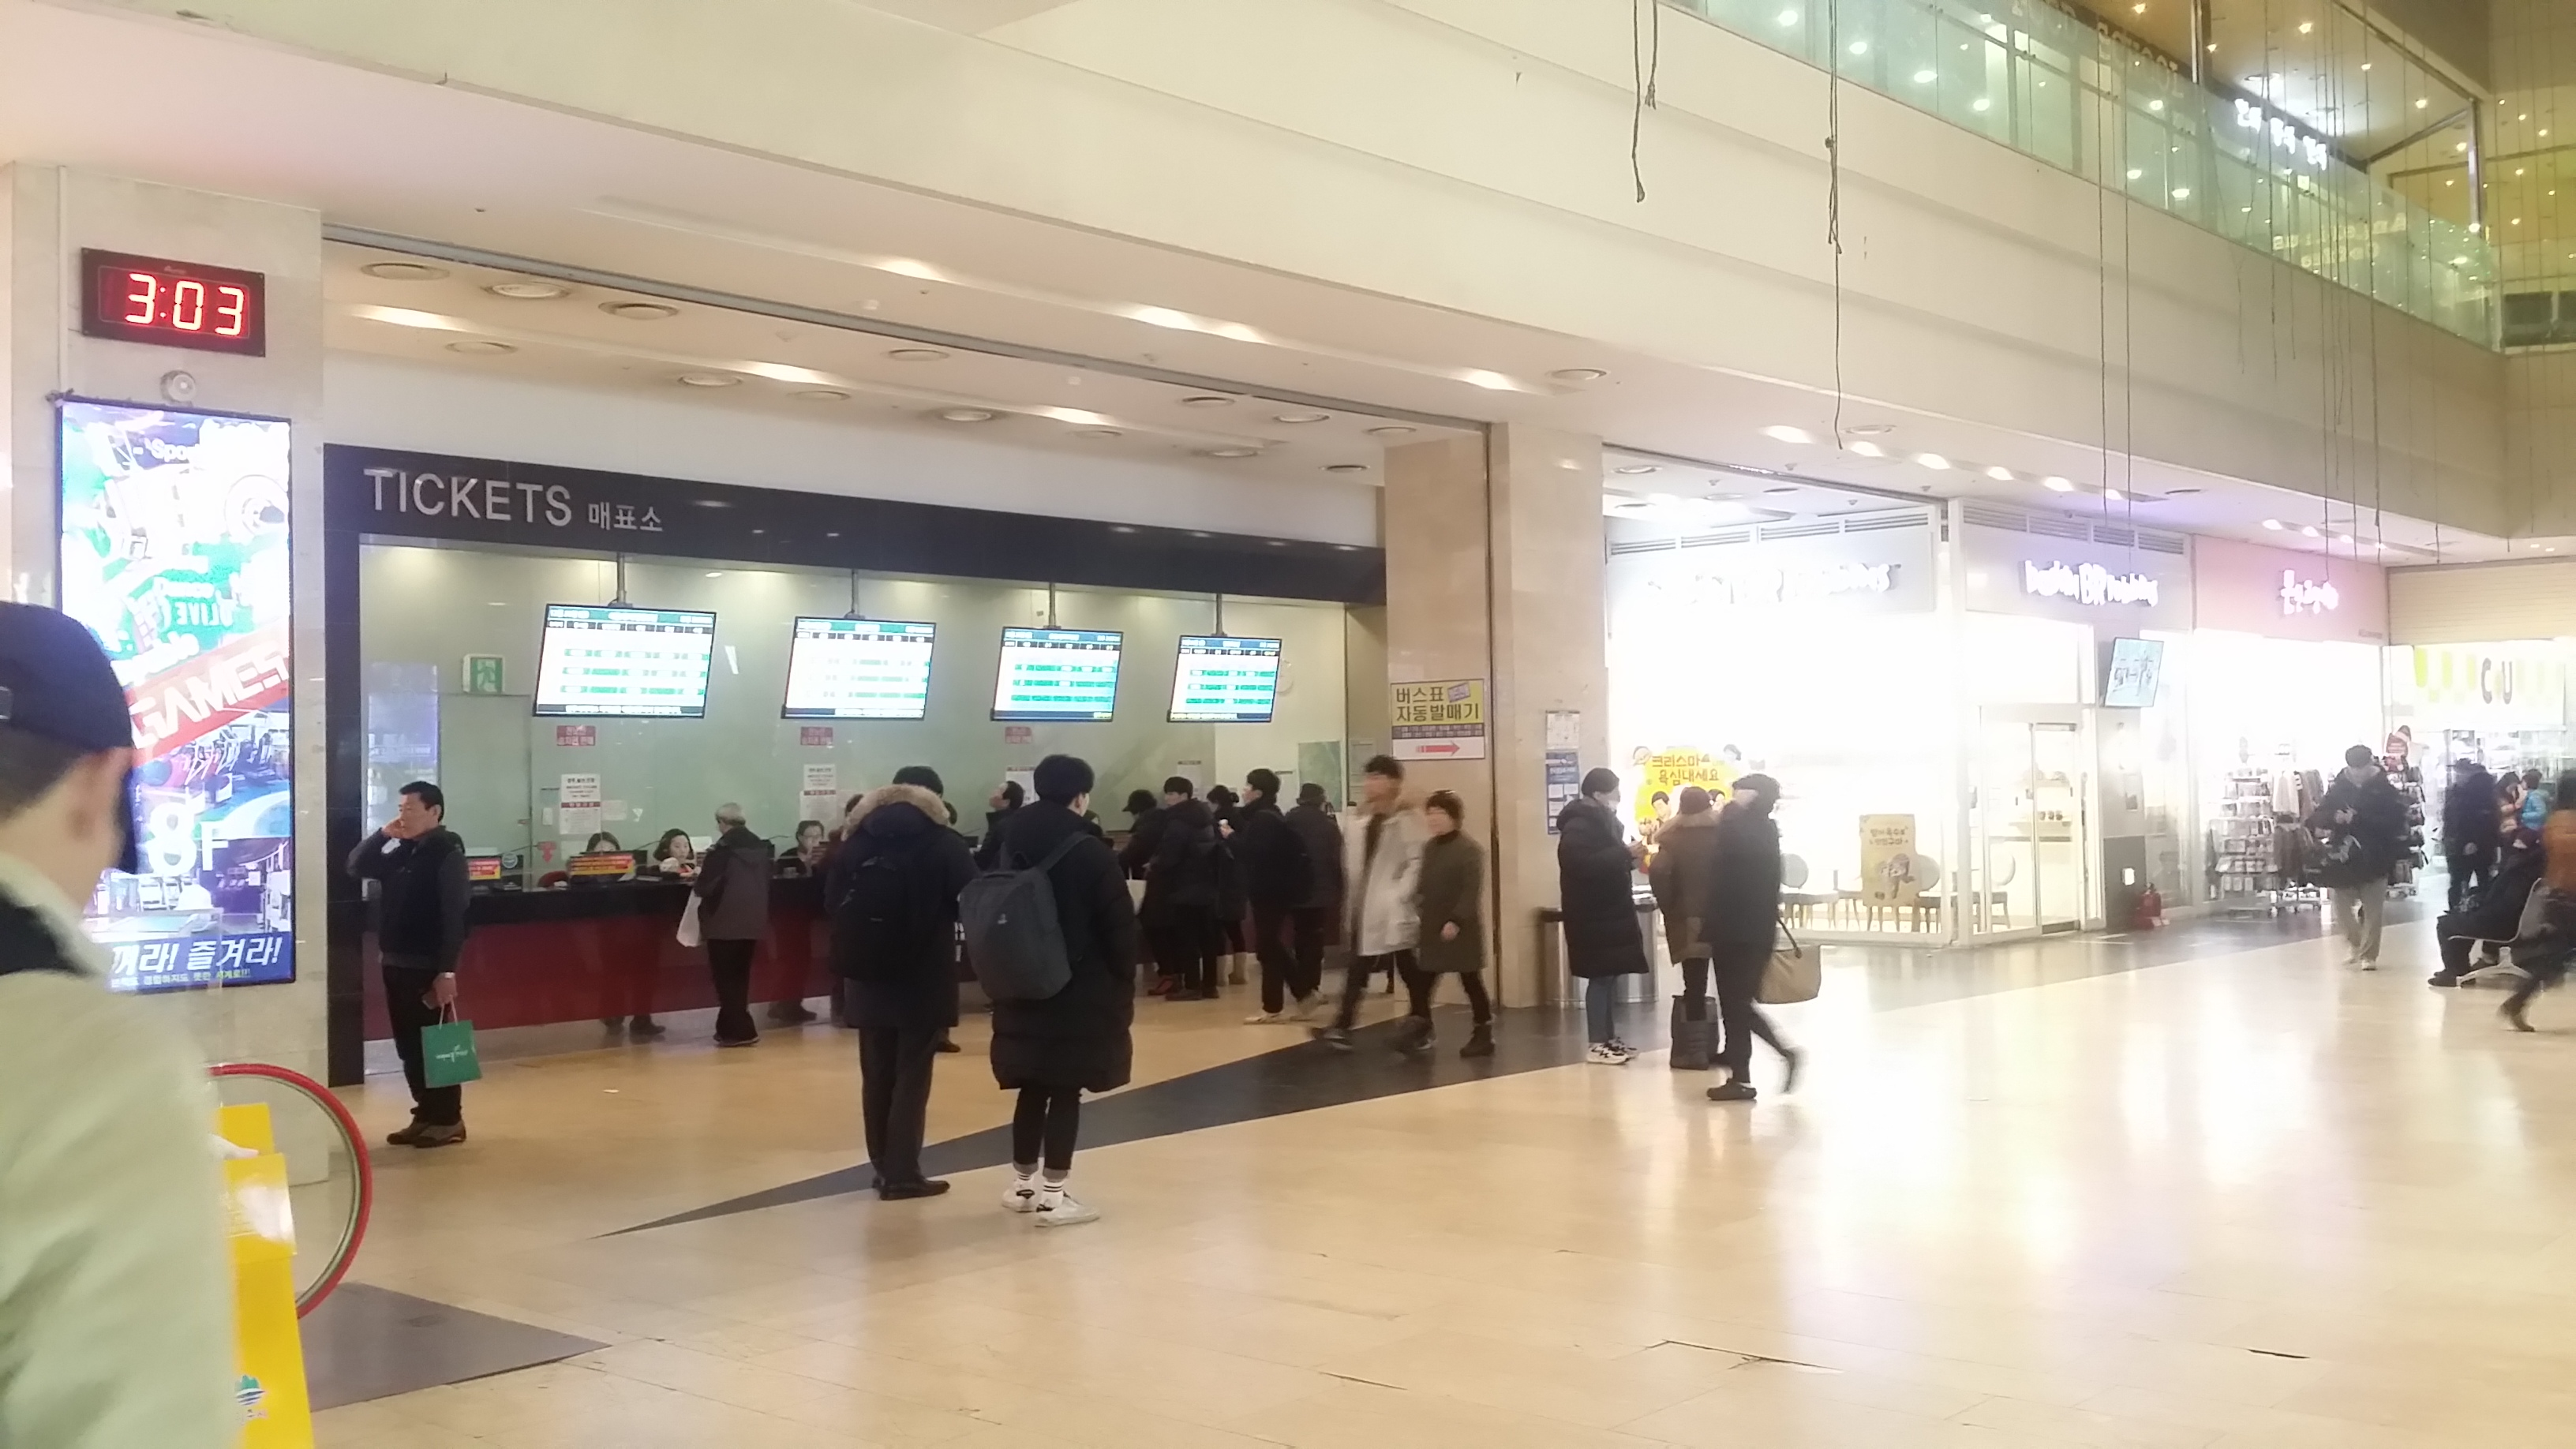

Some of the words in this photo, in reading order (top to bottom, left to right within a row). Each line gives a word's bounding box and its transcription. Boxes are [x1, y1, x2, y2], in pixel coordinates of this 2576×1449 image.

[125, 272, 245, 336] 3:03
[363, 468, 572, 527] TICKETS
[588, 501, 664, 532] 매표소
[1395, 687, 1444, 705] 버스표
[2481, 657, 2513, 705] CU
[1396, 703, 1479, 722] 자동발매기
[1658, 769, 1719, 786] 욕심내세요
[187, 937, 283, 971] 즐겨라!
